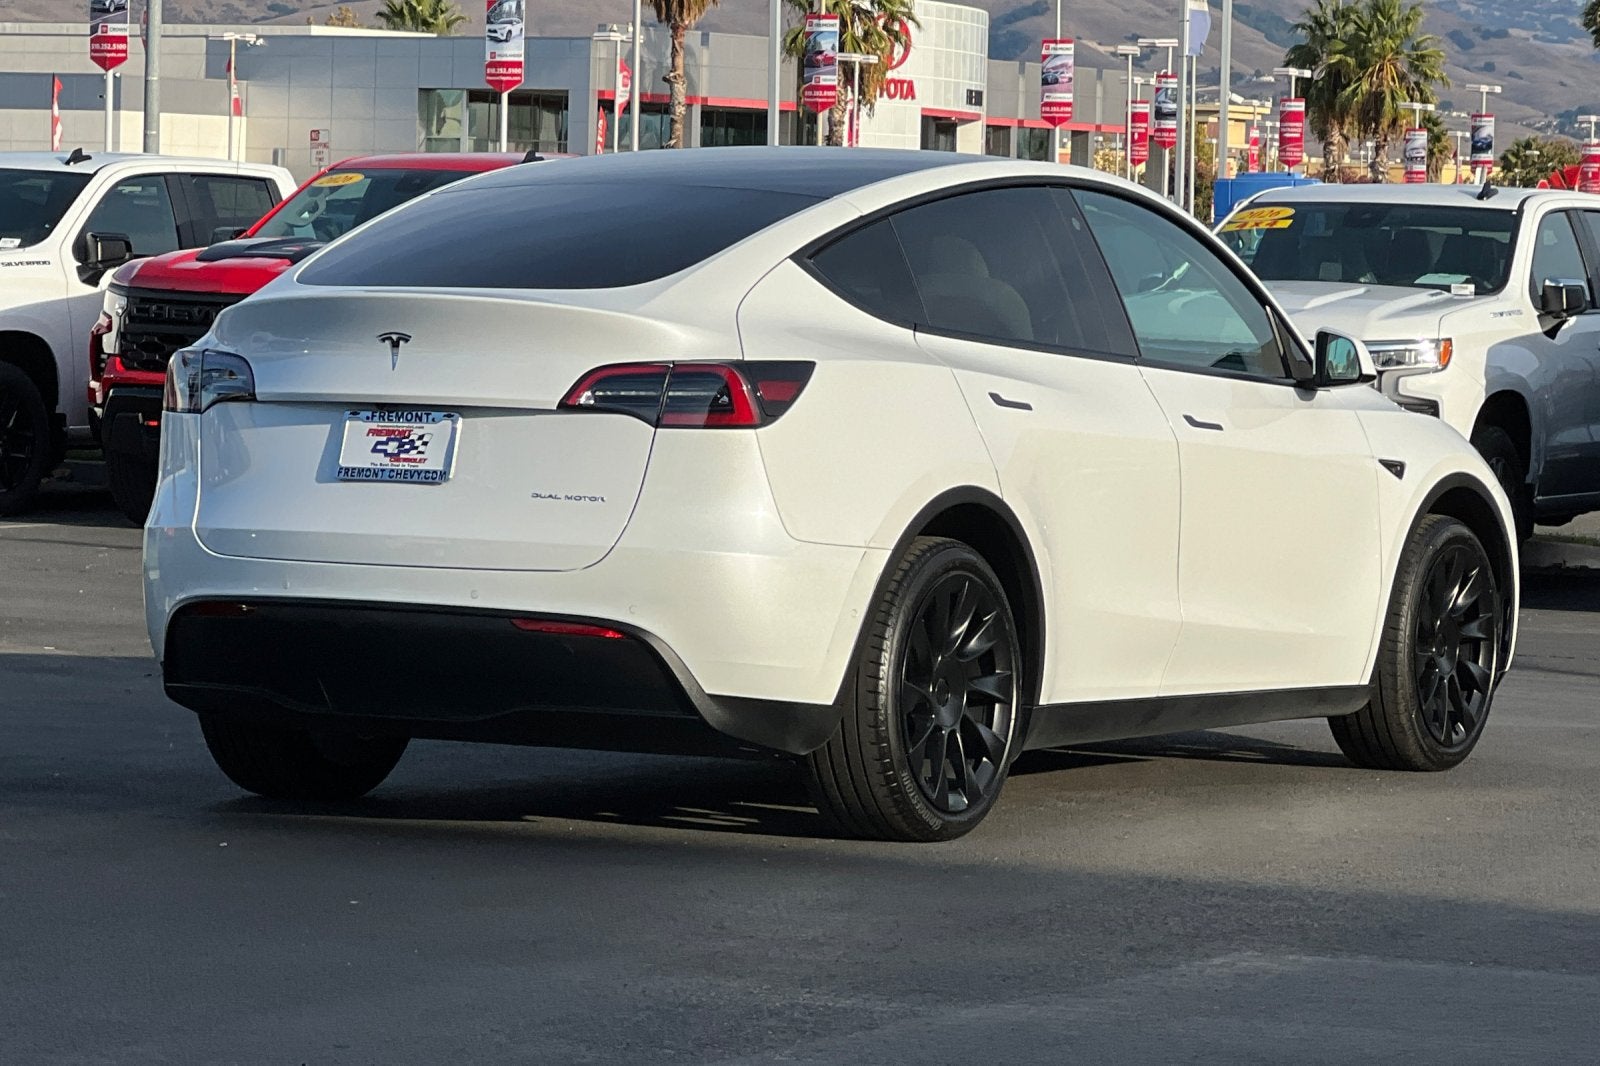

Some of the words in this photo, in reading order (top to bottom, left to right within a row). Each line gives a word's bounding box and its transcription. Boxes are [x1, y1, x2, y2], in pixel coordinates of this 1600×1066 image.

[879, 77, 916, 100] YOTA
[371, 412, 432, 422] FREMONT
[366, 428, 414, 437] FREMONT
[337, 467, 387, 479] FREMONT
[388, 469, 446, 480] CHEVY.COM
